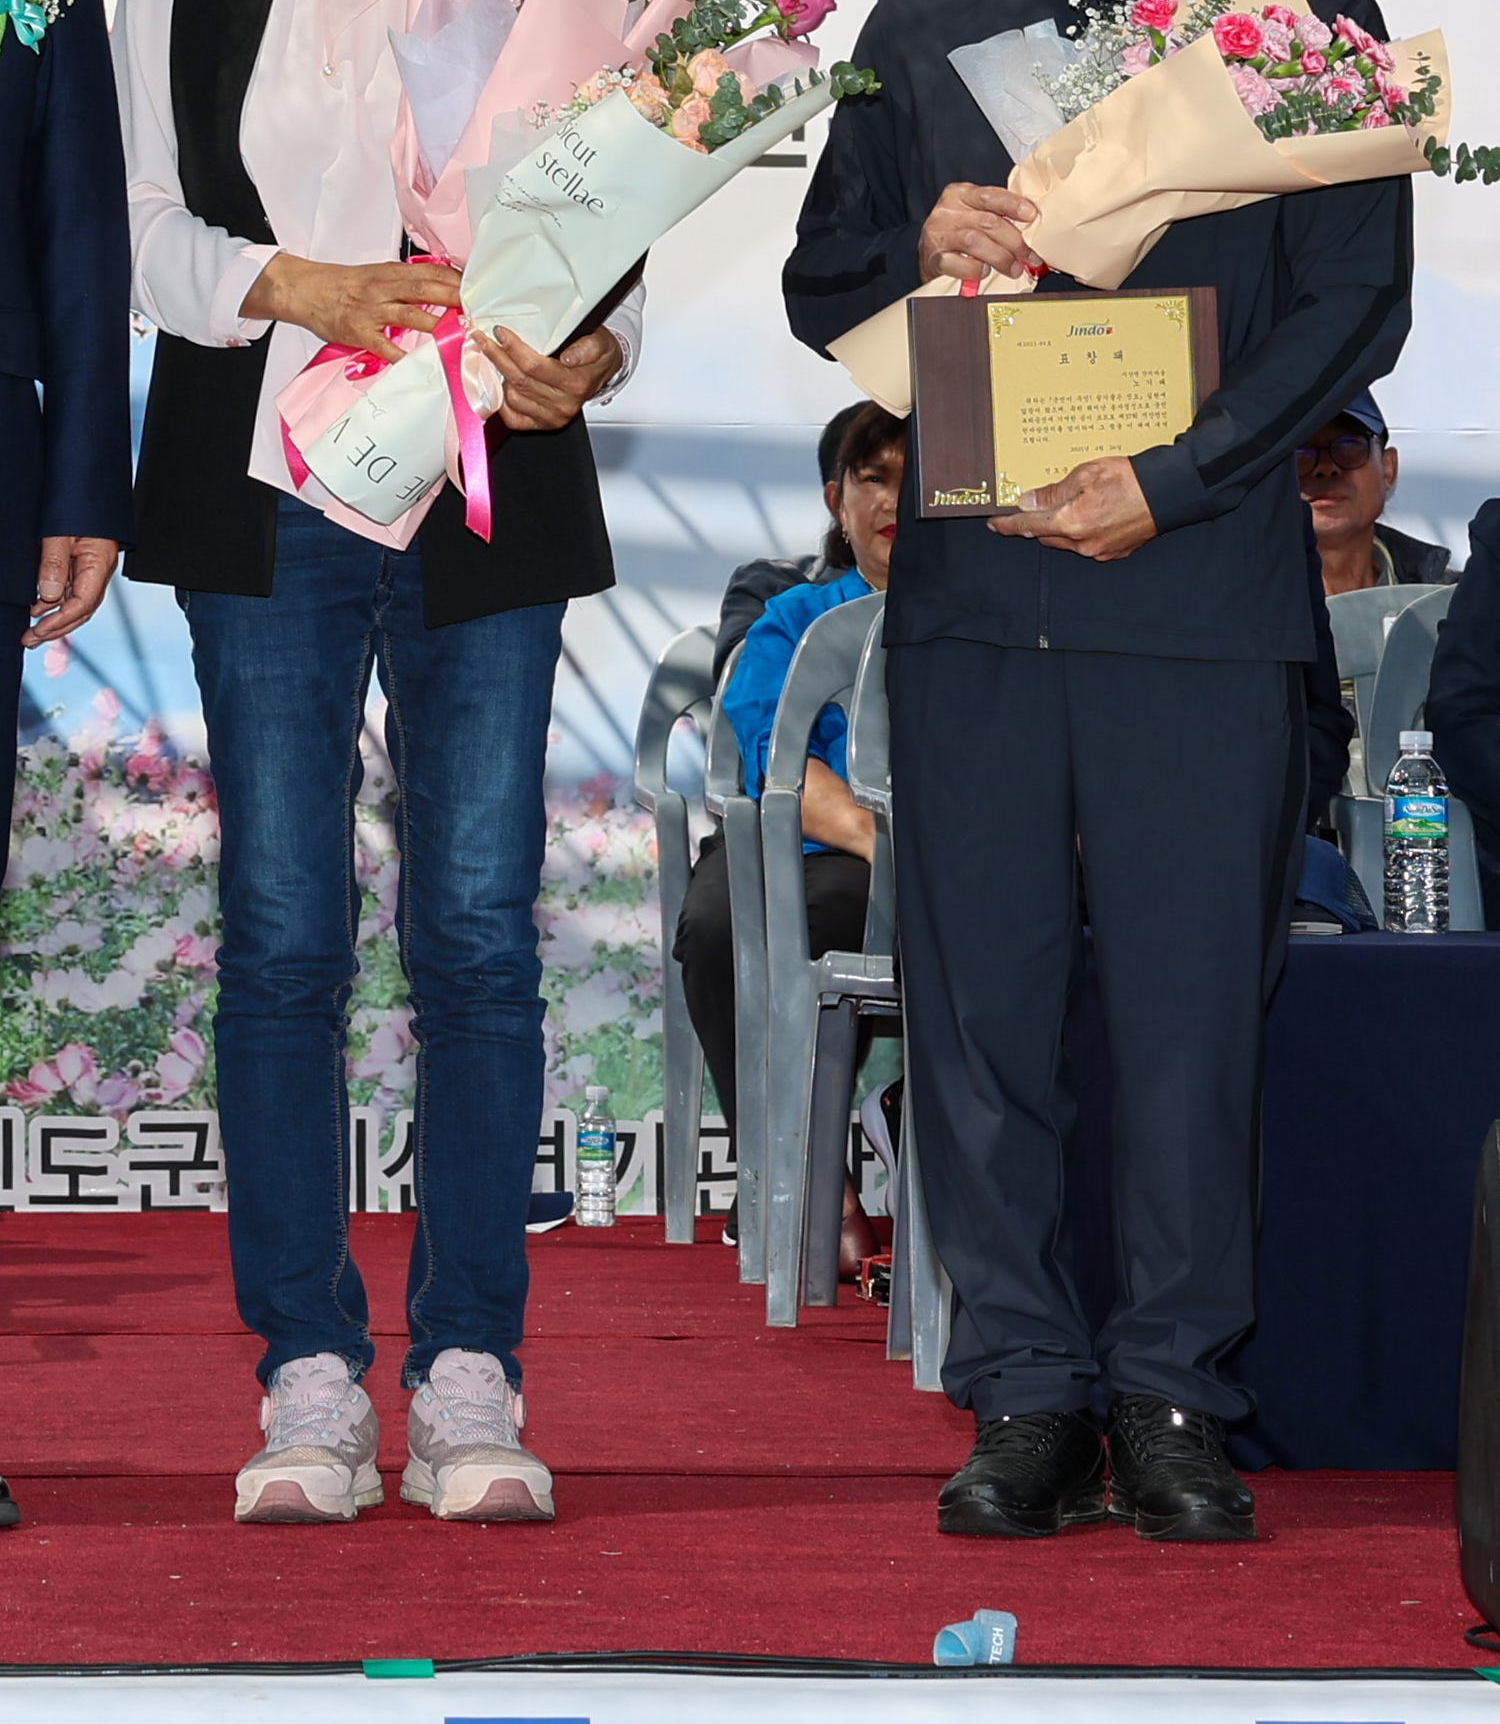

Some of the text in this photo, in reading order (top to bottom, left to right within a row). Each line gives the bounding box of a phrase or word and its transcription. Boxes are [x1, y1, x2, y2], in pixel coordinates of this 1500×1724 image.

[556, 120, 598, 168] sicut
[536, 151, 605, 220] stellae
[1066, 325, 1104, 337] Jindo
[1059, 353, 1069, 364] 표
[1087, 350, 1096, 364] 창
[929, 489, 981, 508] Jindo
[989, 1627, 1004, 1665] TECH
